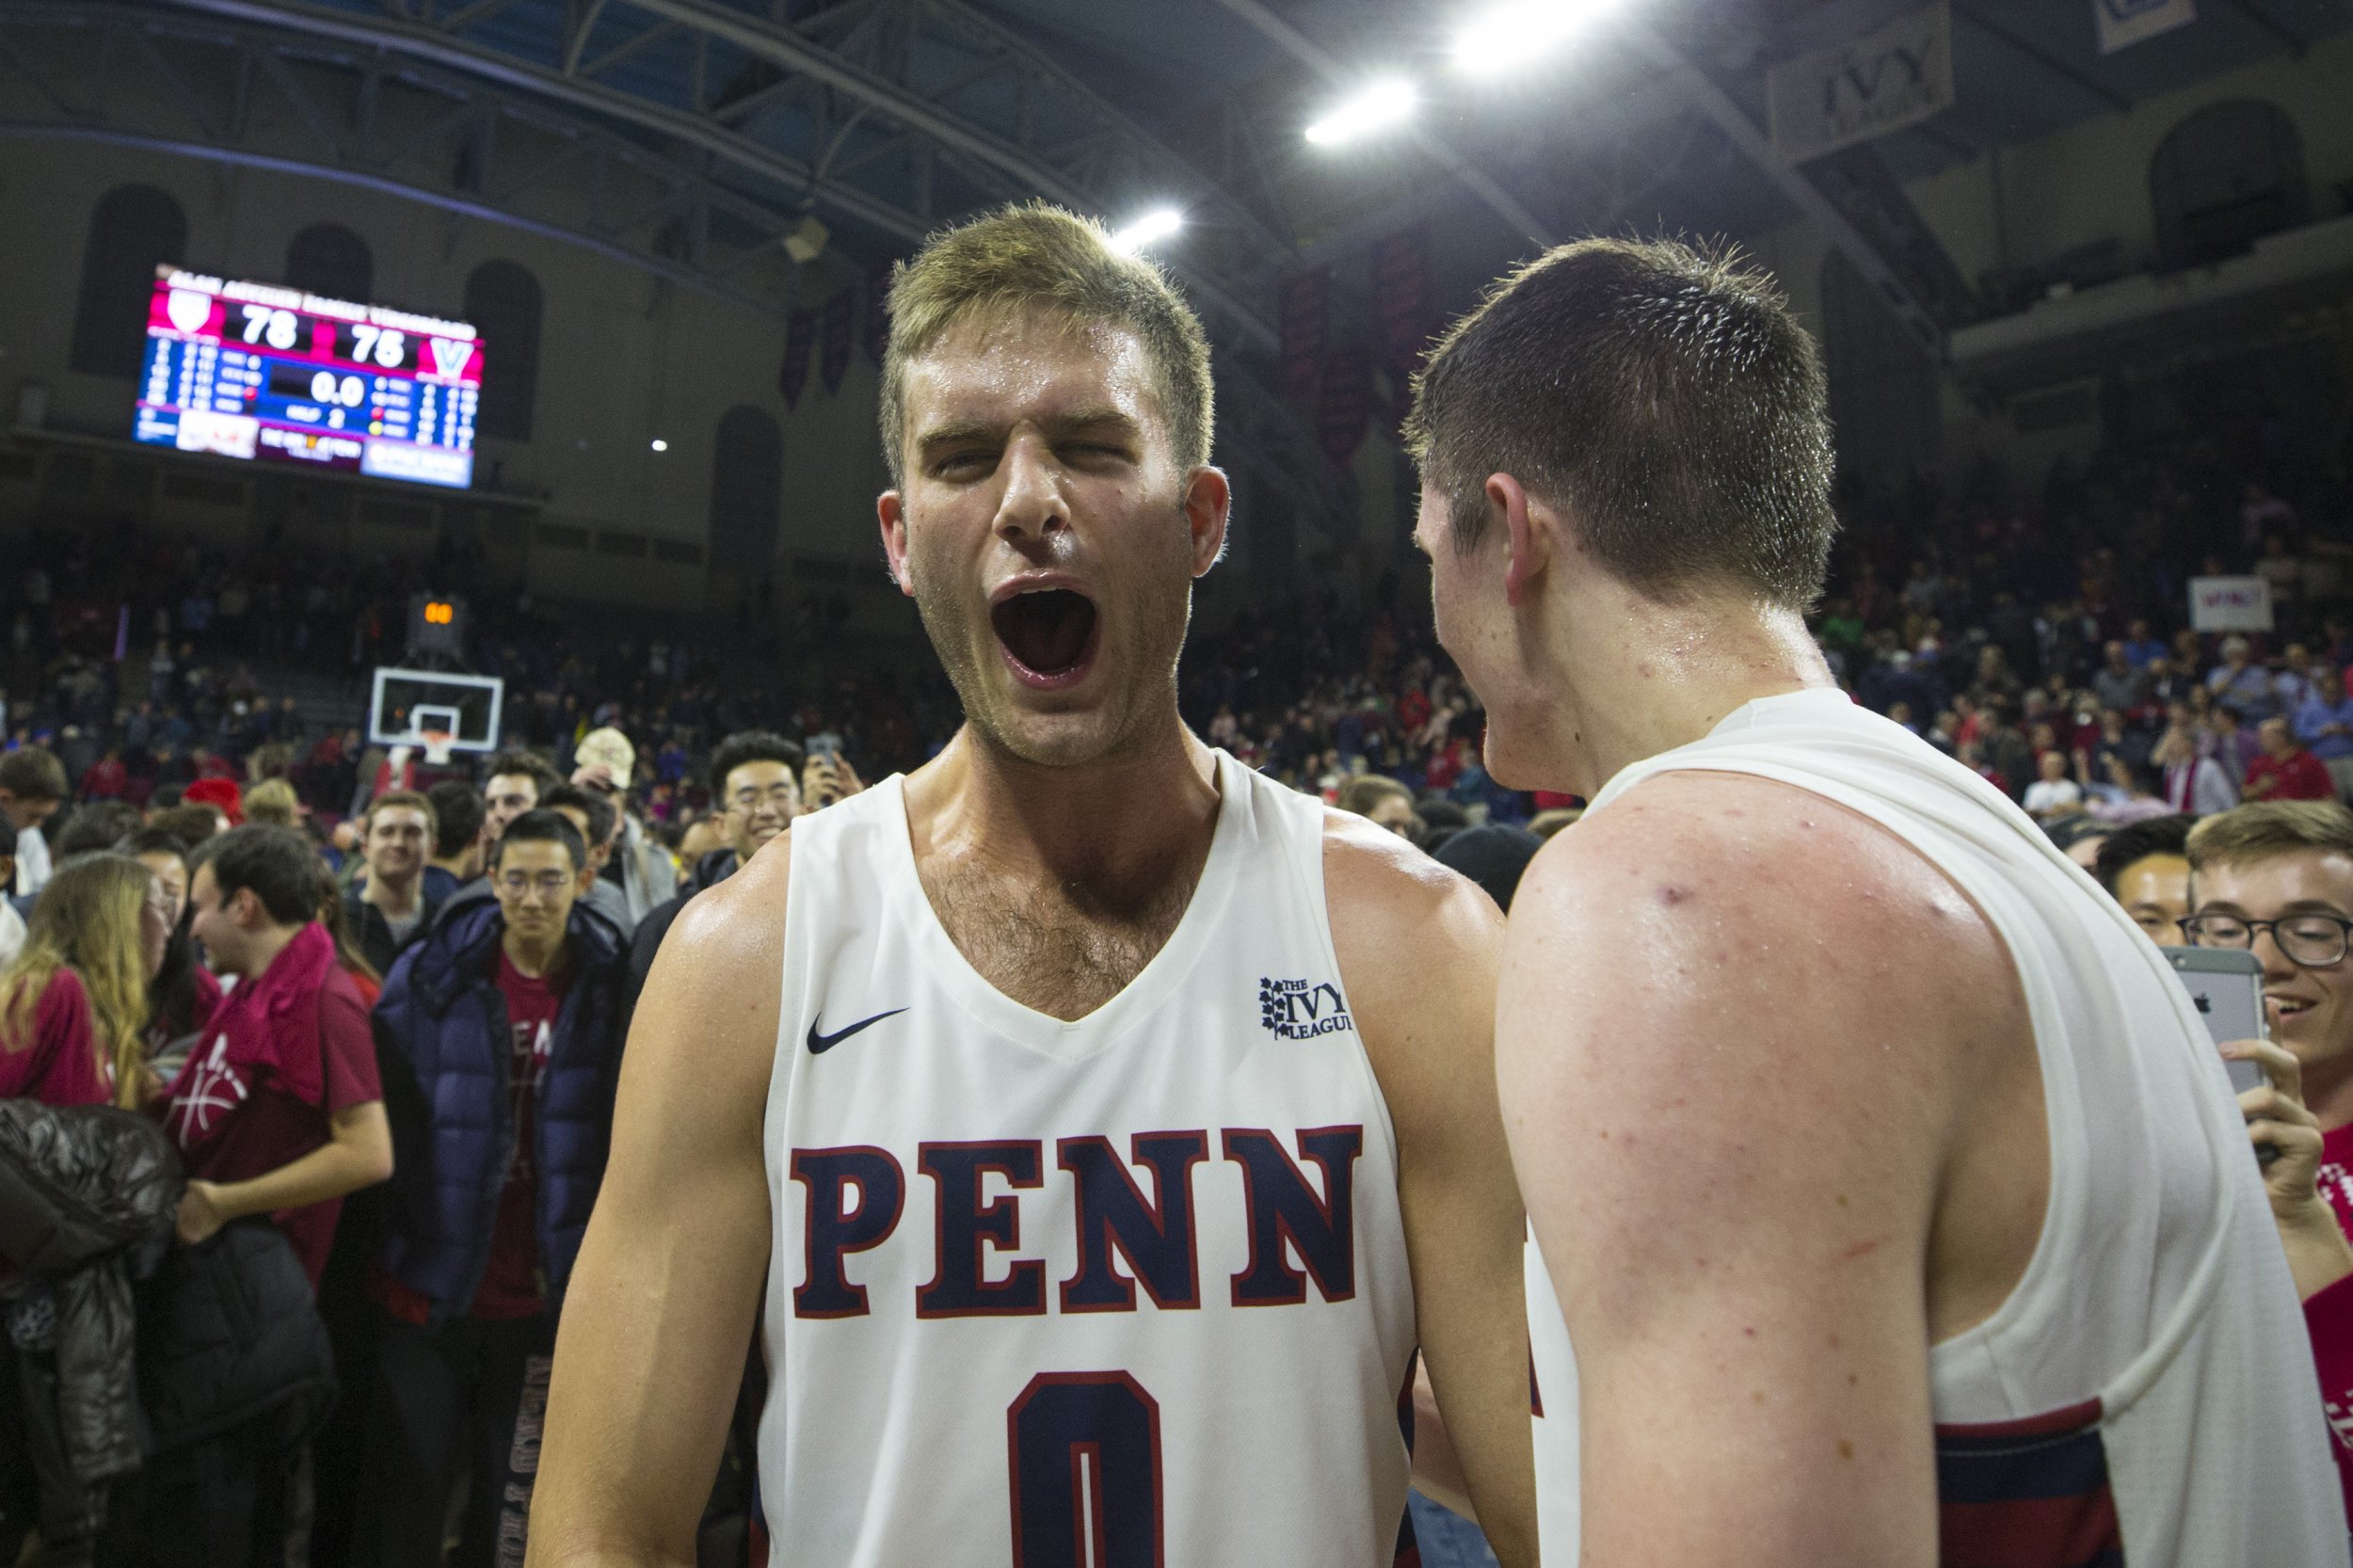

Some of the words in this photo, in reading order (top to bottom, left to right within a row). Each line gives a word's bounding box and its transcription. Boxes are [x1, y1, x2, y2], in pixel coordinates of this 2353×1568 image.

[1823, 36, 1935, 115] IVY
[242, 303, 297, 350] 78
[351, 324, 405, 368] 75
[310, 371, 365, 408] 0.0
[1282, 979, 1308, 991] THE
[1283, 983, 1346, 1022] IVY
[790, 1125, 1363, 1319] PENN
[1007, 1370, 1164, 1568] 0
